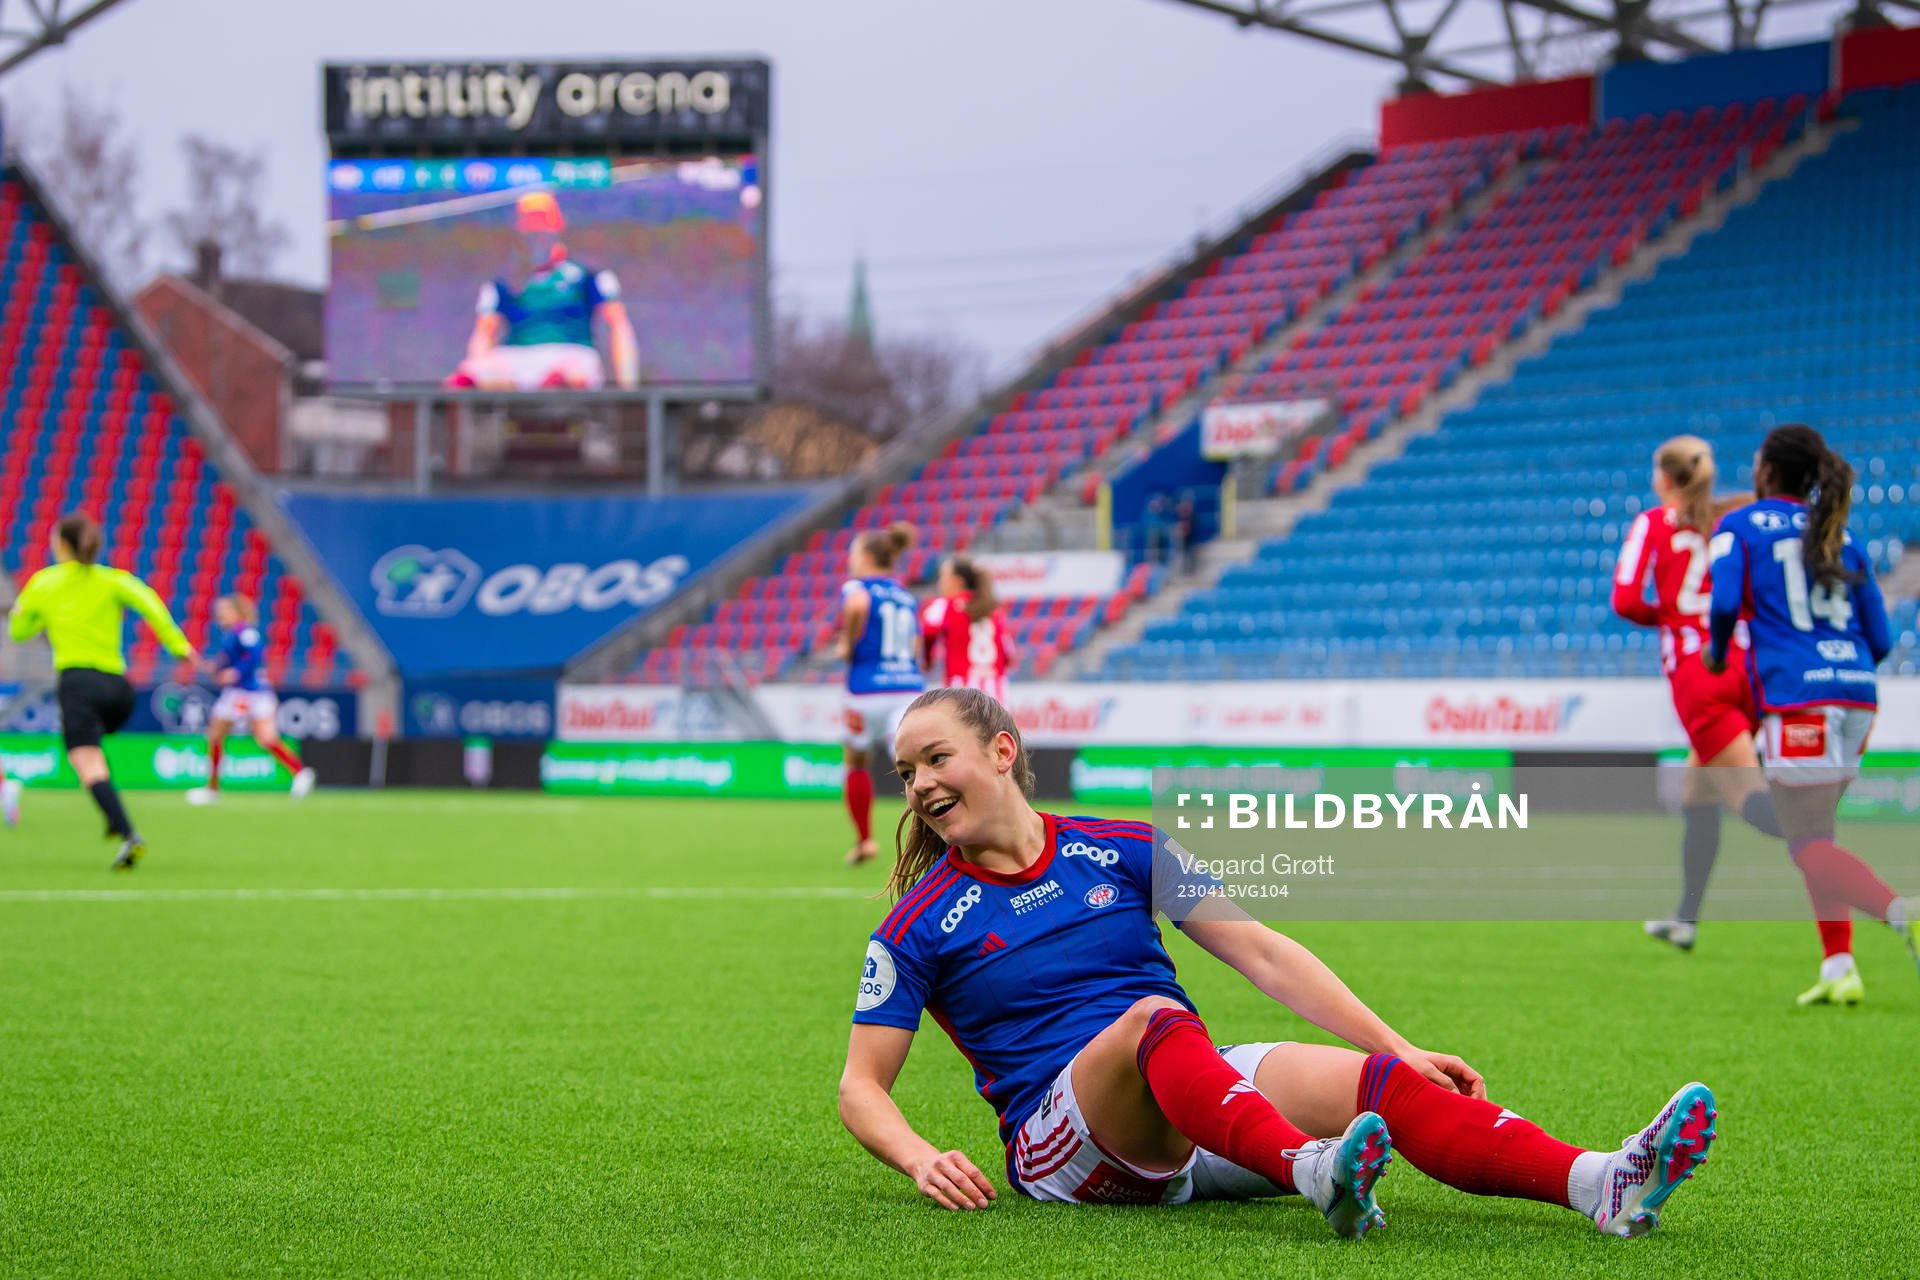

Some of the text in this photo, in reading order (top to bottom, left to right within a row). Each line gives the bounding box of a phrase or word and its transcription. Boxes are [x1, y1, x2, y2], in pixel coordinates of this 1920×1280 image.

[347, 64, 730, 130] intility arena
[477, 555, 690, 616] OBOS
[1773, 537, 1853, 633] 14
[1061, 841, 1119, 867] coop
[940, 884, 982, 933] coop
[1015, 889, 1064, 916] RECYCLING
[1021, 879, 1060, 904] STENA
